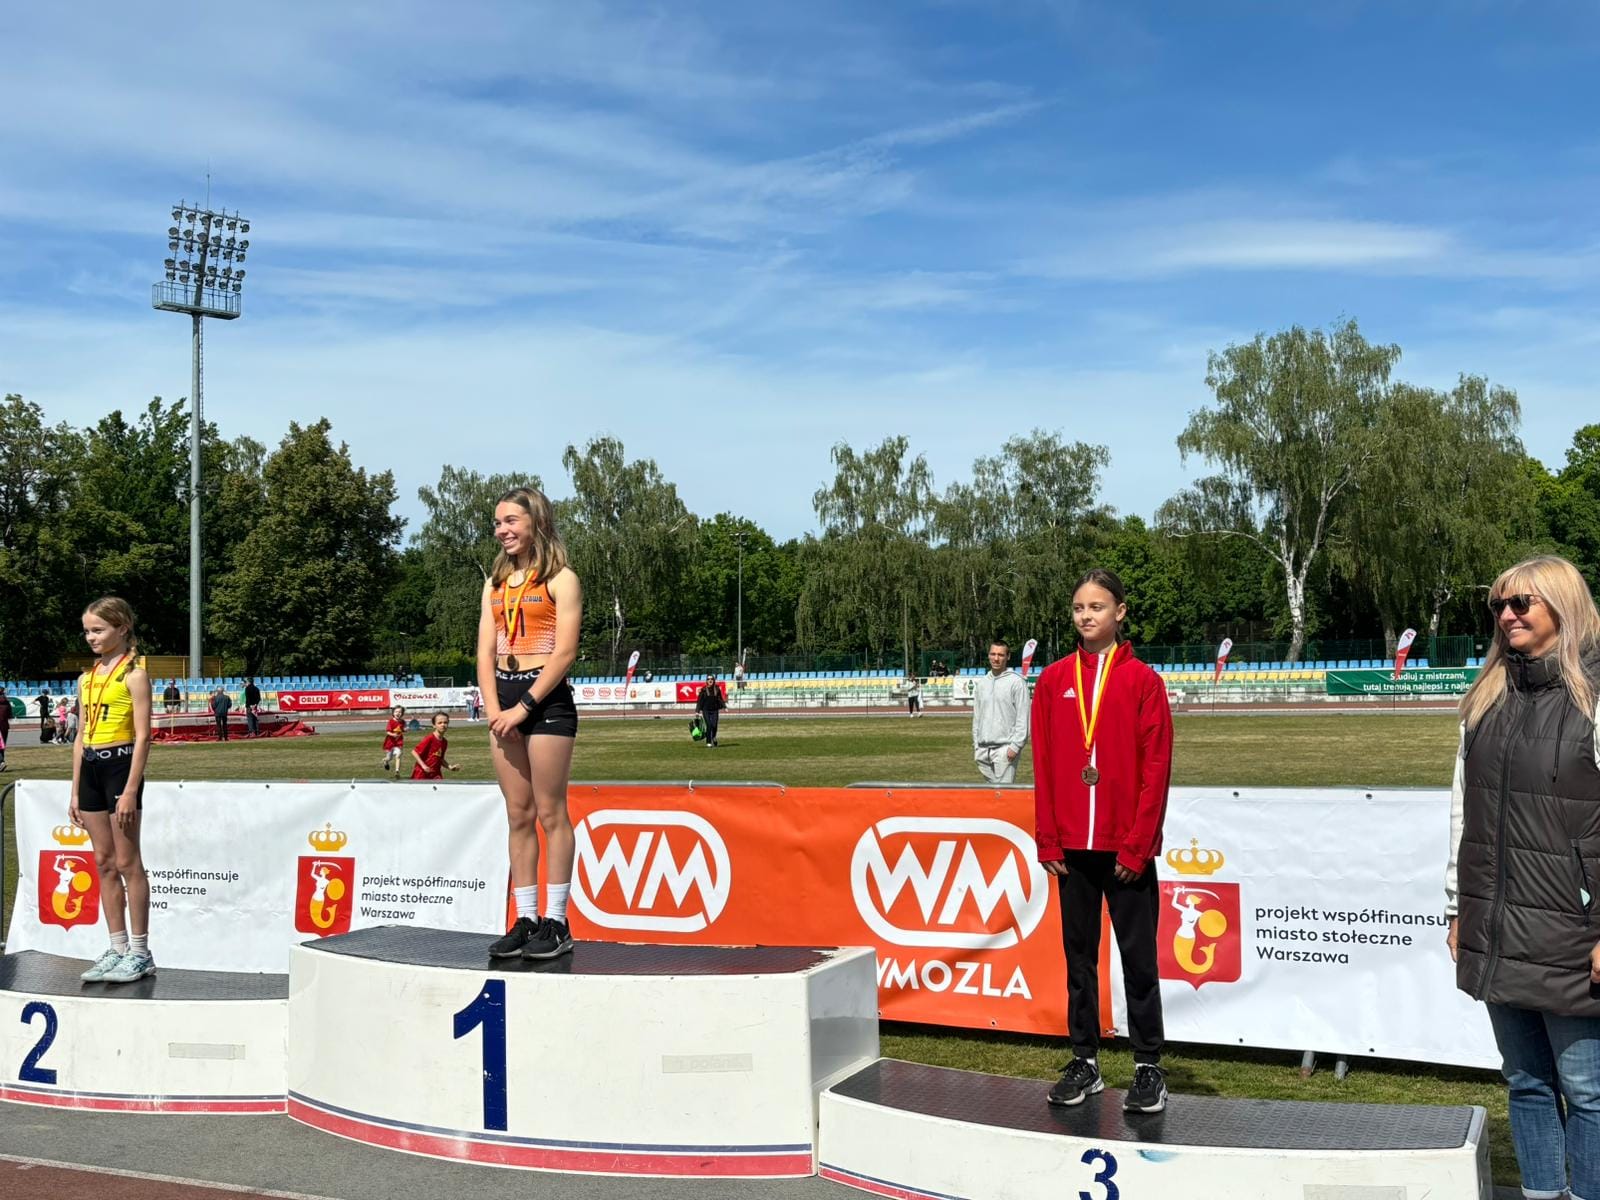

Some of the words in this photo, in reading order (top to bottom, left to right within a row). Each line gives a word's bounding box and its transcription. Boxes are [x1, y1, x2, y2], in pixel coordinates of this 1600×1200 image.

[1390, 671, 1418, 682] Sudiuj
[1425, 671, 1467, 681] mistrzami,
[1363, 683, 1382, 692] tutaj
[1383, 683, 1411, 692] trenują
[1413, 682, 1443, 692] najlepsi
[300, 695, 328, 704] ORLEN
[358, 695, 383, 703] ORLEN
[152, 868, 239, 884] współfinansuje
[572, 814, 724, 925] WM
[151, 884, 207, 896] stołeczne
[361, 874, 401, 888] projekt
[402, 875, 486, 891] współfinansuje
[854, 822, 1043, 942] WM
[361, 891, 398, 902] miasto
[400, 892, 453, 904] stołeczne
[360, 906, 415, 919] Warszawa
[1255, 906, 1319, 922] projekt
[1322, 909, 1451, 930] współfinansu
[1256, 926, 1318, 941] miasto
[1322, 926, 1413, 946] stołeczne
[1256, 946, 1349, 964] Warszawa
[18, 1001, 58, 1085] 2
[453, 979, 508, 1132] 1
[1078, 1148, 1120, 1200] 3
